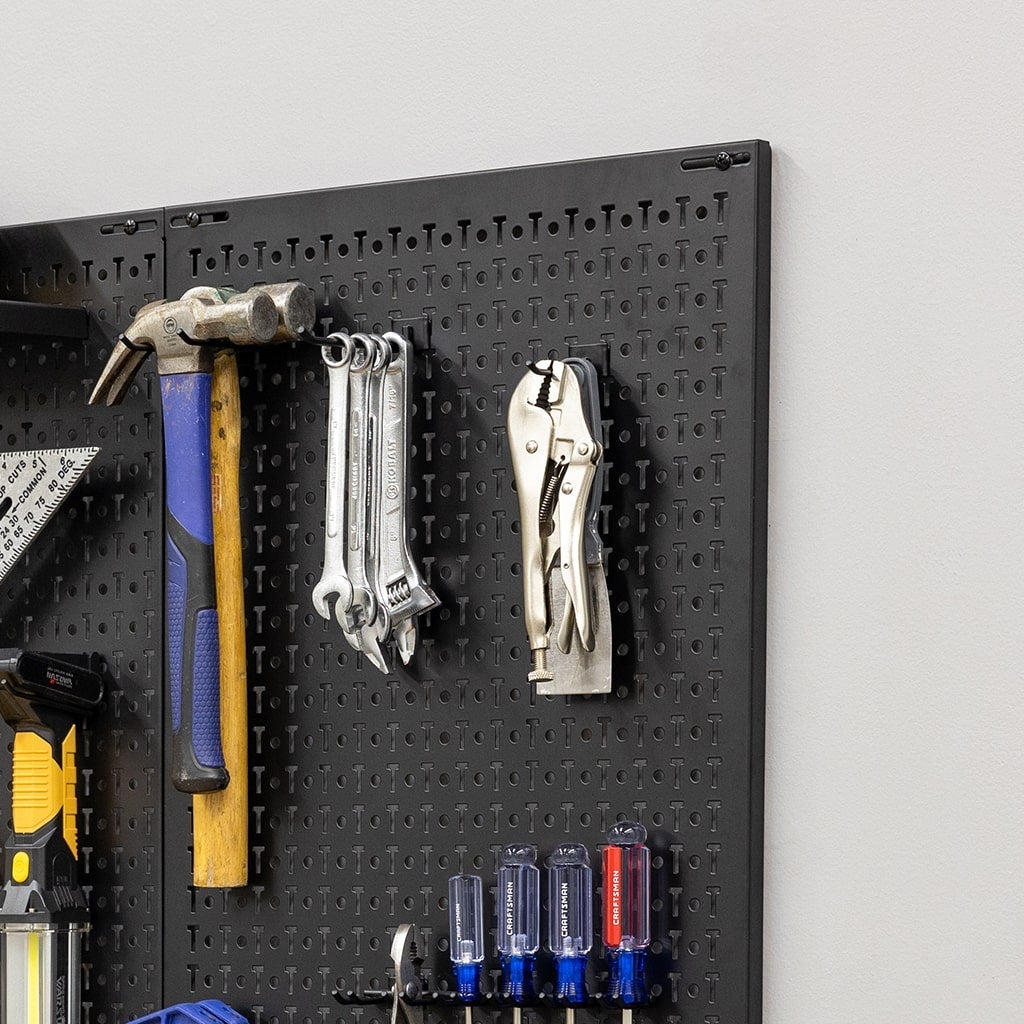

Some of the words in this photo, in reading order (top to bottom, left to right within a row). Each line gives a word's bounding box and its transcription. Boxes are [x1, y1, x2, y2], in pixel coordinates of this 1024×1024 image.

[1, 462, 7, 470] 4
[32, 459, 38, 469] 5
[60, 456, 65, 466] 6
[7, 460, 27, 484] CUTS
[387, 440, 397, 484] KOBALT
[18, 466, 47, 504] COMMON
[3, 538, 14, 551] 60
[14, 526, 23, 538] 65
[24, 512, 34, 524] 70
[35, 496, 46, 509] 75
[47, 479, 58, 492] 80
[57, 459, 76, 479] DEG.
[0, 527, 10, 539] 24
[9, 515, 19, 527] 30
[612, 870, 620, 926] CRAFTSMAN
